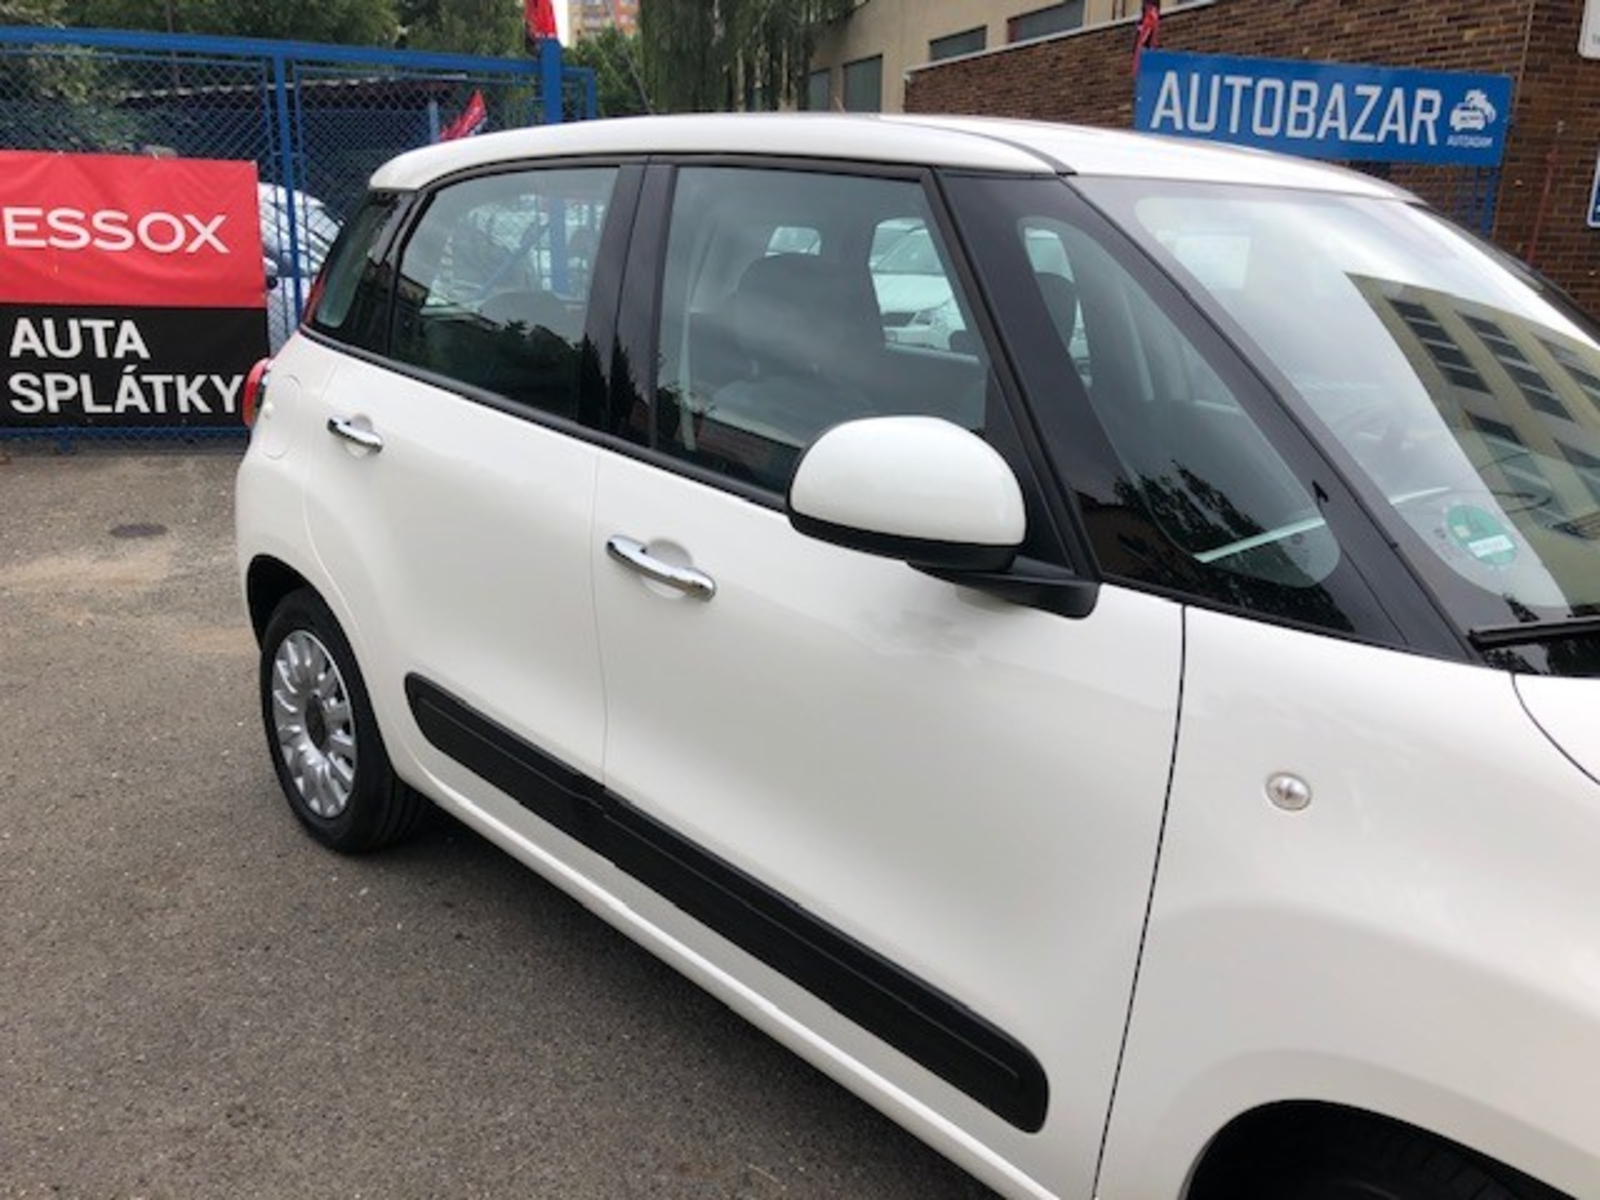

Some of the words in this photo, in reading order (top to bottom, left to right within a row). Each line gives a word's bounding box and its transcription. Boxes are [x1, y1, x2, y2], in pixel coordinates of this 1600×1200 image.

[1150, 70, 1442, 146] AUTOBAZAR
[3, 207, 231, 254] ESSOX
[9, 317, 151, 359] AUTA
[8, 364, 245, 414] SPLÁTKY
